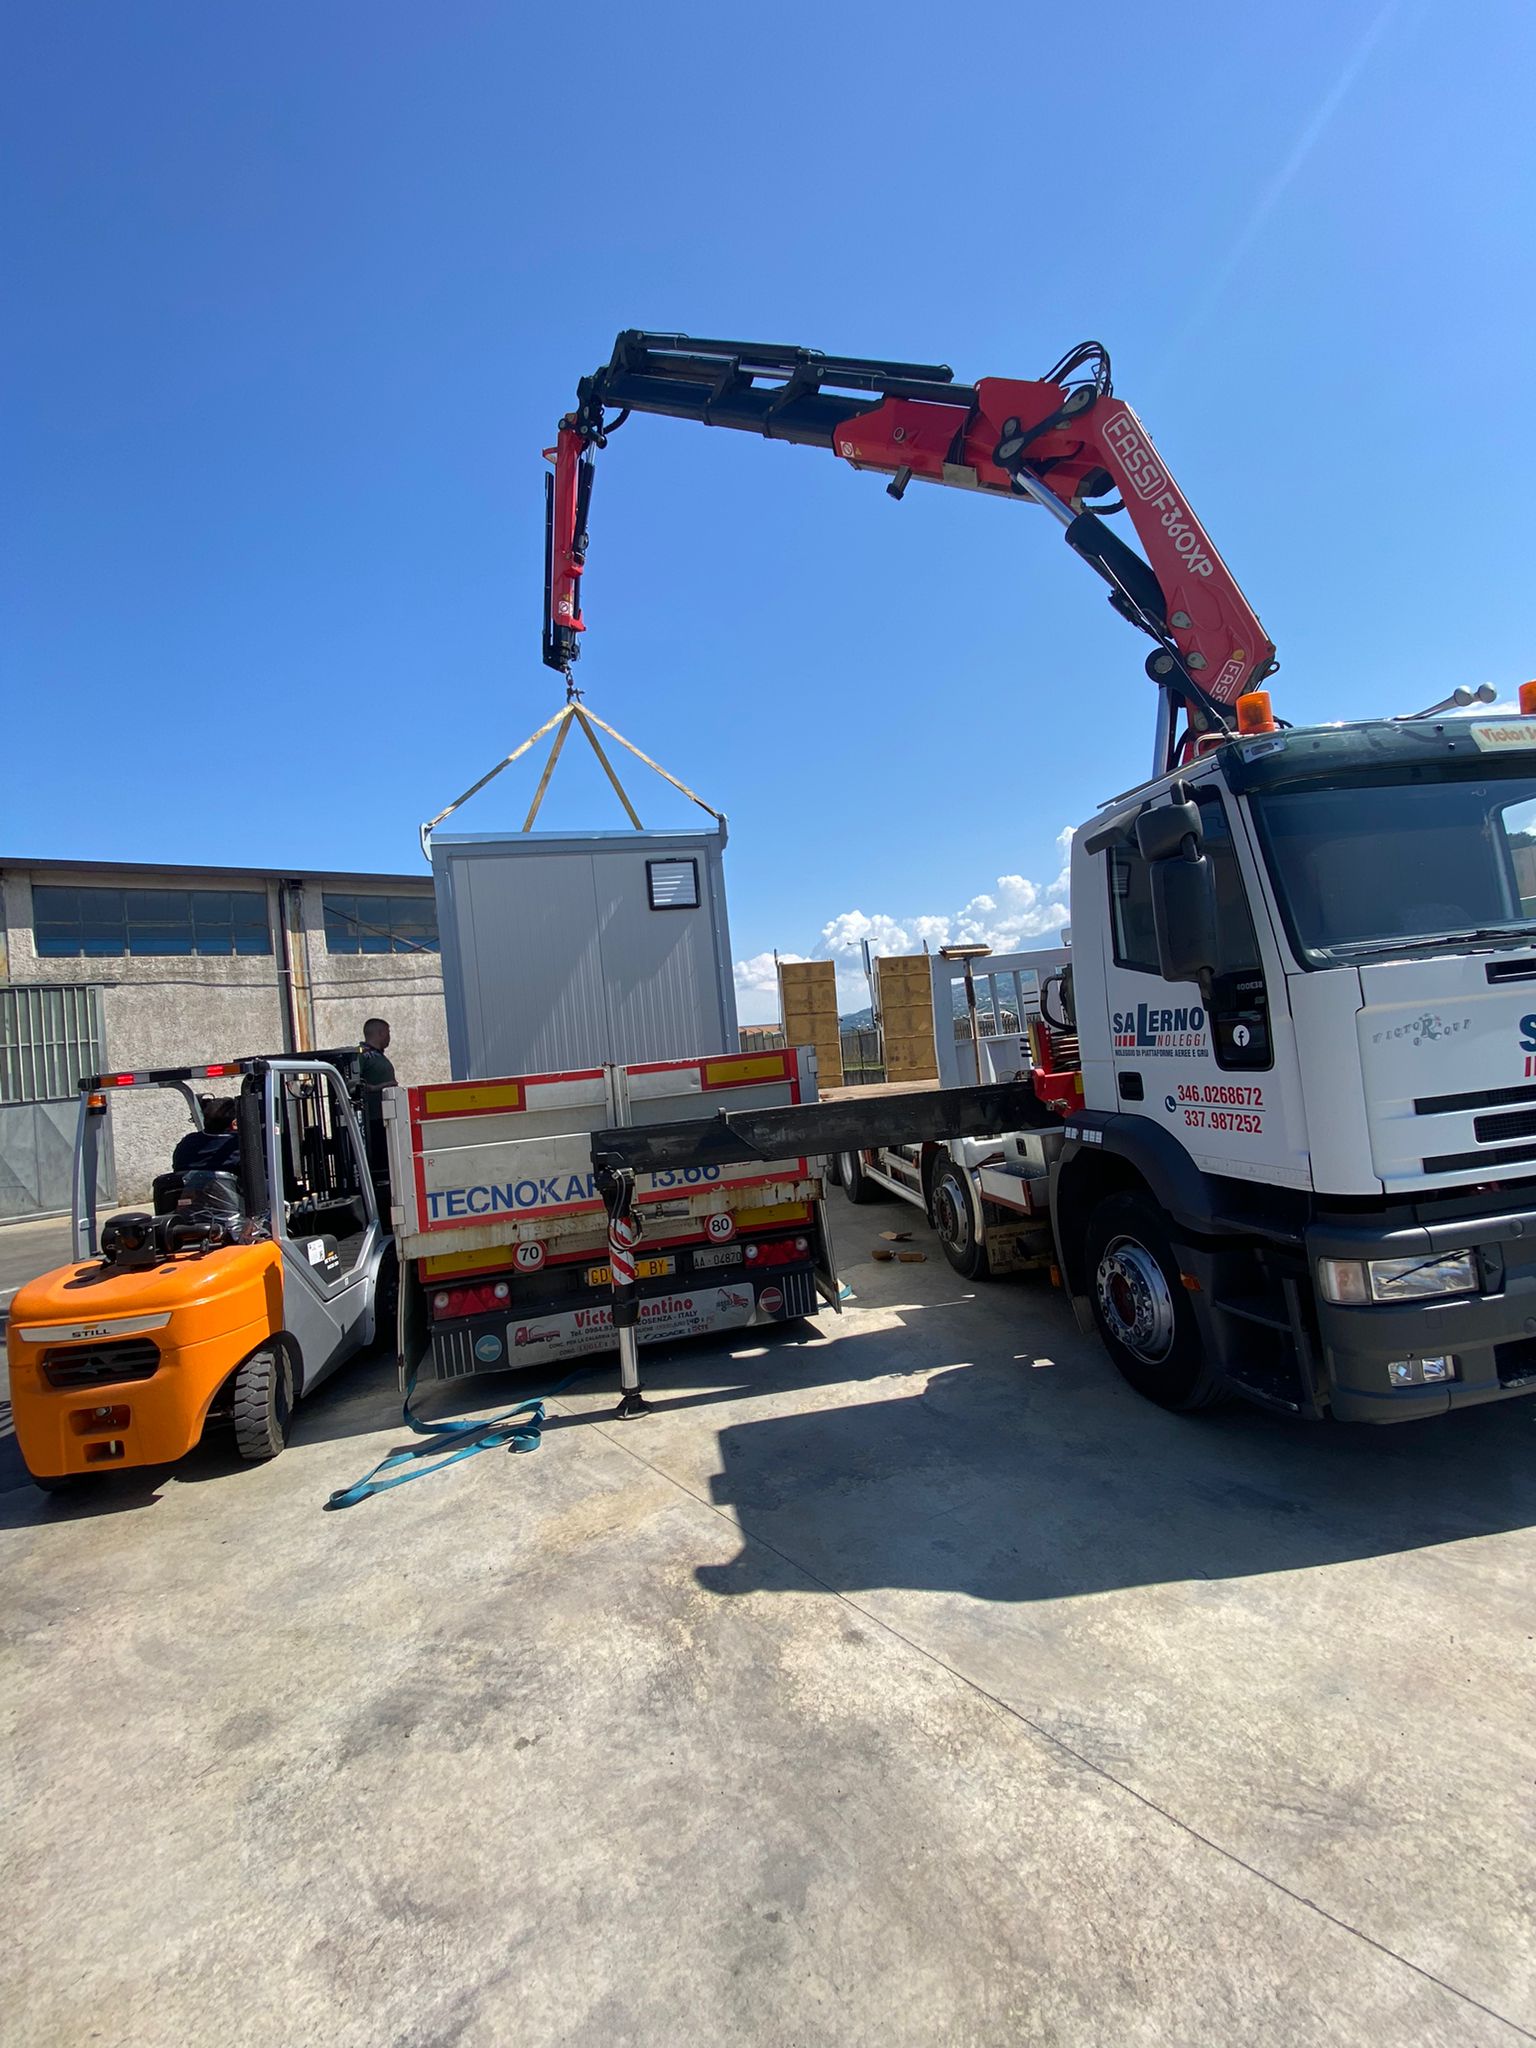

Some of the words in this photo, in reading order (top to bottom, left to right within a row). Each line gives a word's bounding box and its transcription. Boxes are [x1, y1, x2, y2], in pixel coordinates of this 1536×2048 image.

[1107, 417, 1162, 495] FASSI
[1151, 491, 1215, 578] F360XP
[1112, 1003, 1205, 1047] SALERNO
[1157, 1033, 1207, 1047] NOLEGGI
[1177, 1084, 1264, 1106] 346.0268672
[1184, 1110, 1263, 1134] 337.987252
[712, 1218, 730, 1232] 80
[520, 1246, 540, 1261] 70
[650, 1260, 665, 1276] BY
[574, 1309, 614, 1328] Victo
[640, 1296, 693, 1317] antino
[678, 1310, 698, 1319] ITALY
[72, 1328, 111, 1338] STILL
